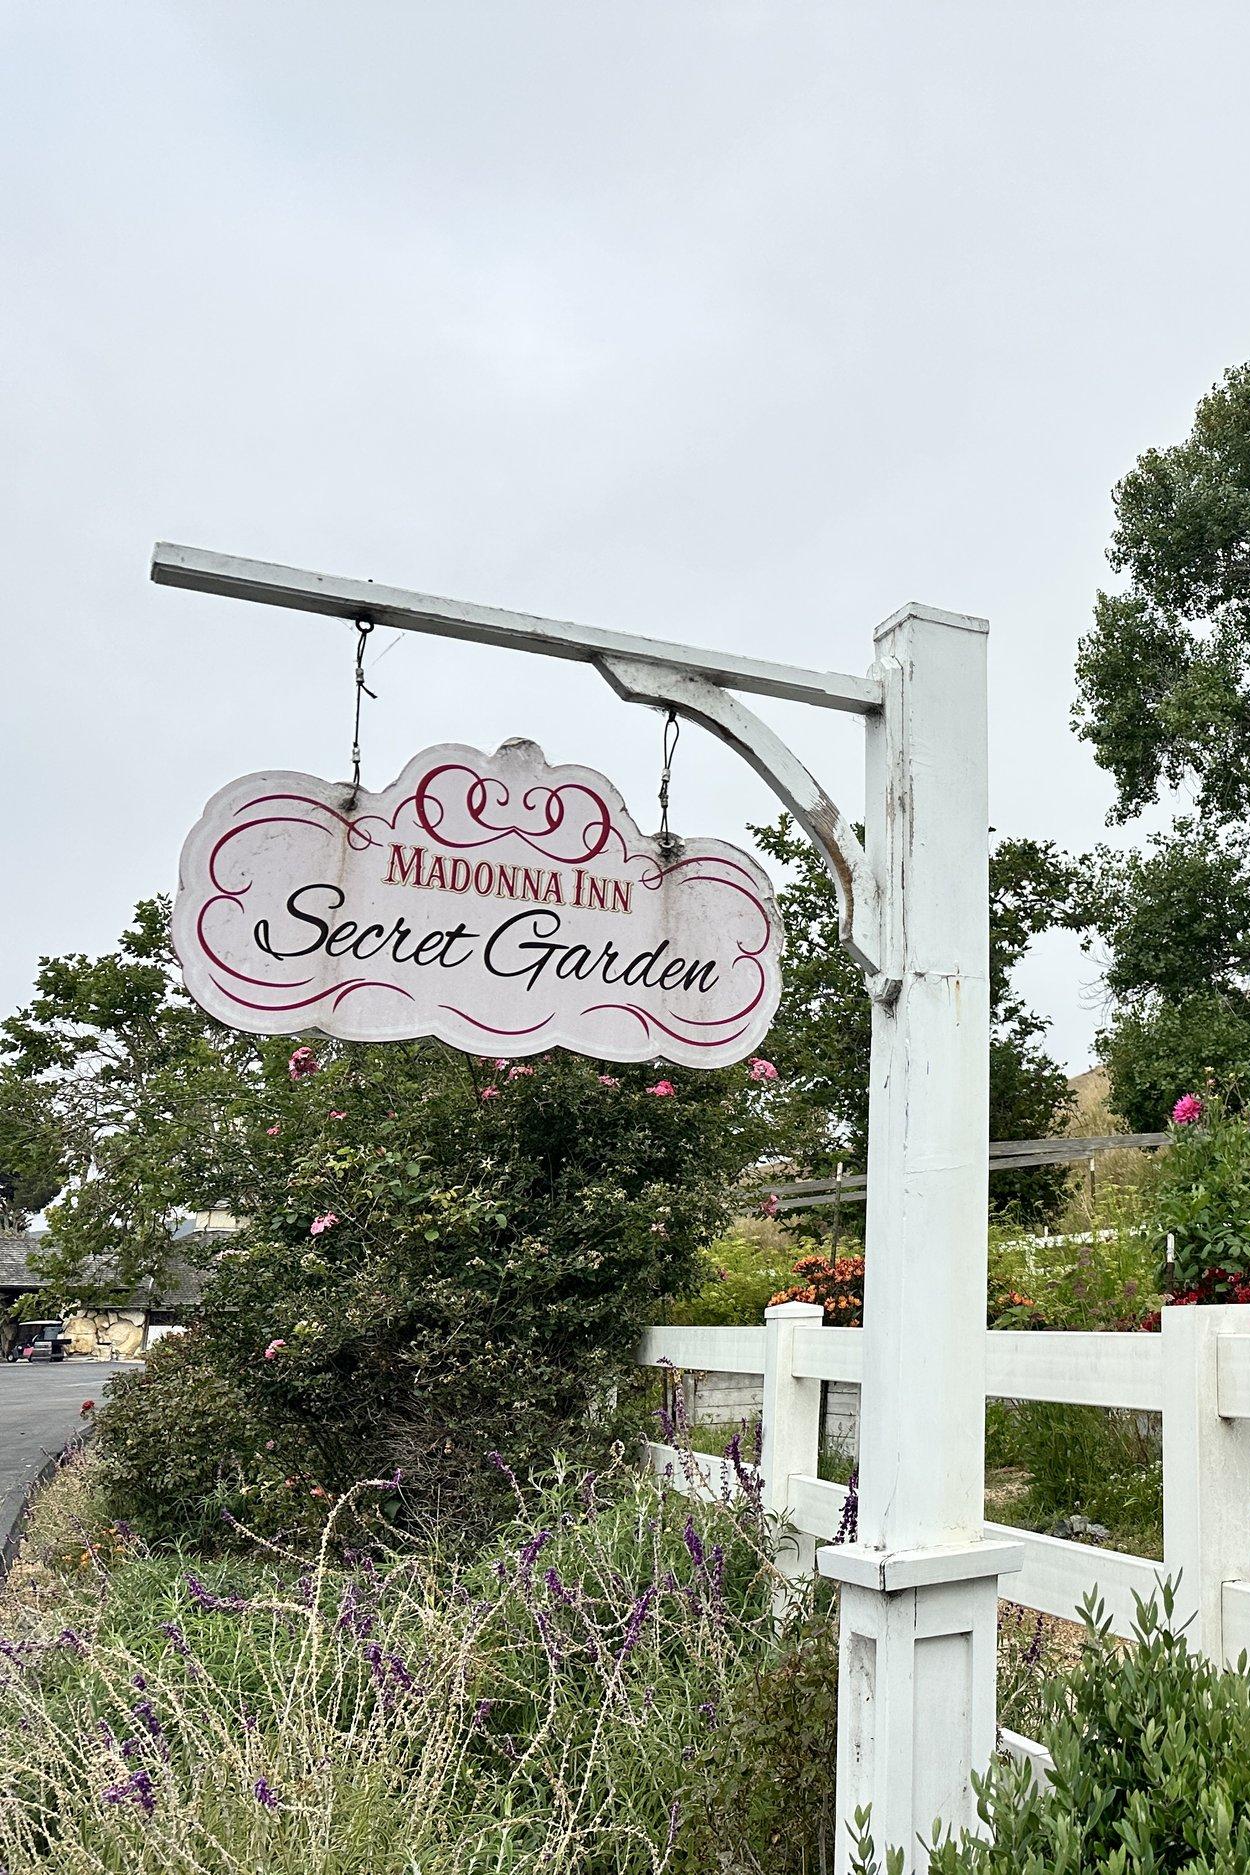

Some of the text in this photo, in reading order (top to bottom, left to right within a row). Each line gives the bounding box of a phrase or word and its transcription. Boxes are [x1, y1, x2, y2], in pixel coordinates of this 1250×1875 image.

[384, 842, 634, 914] MADONNA INN
[253, 883, 720, 993] Secret Garden
